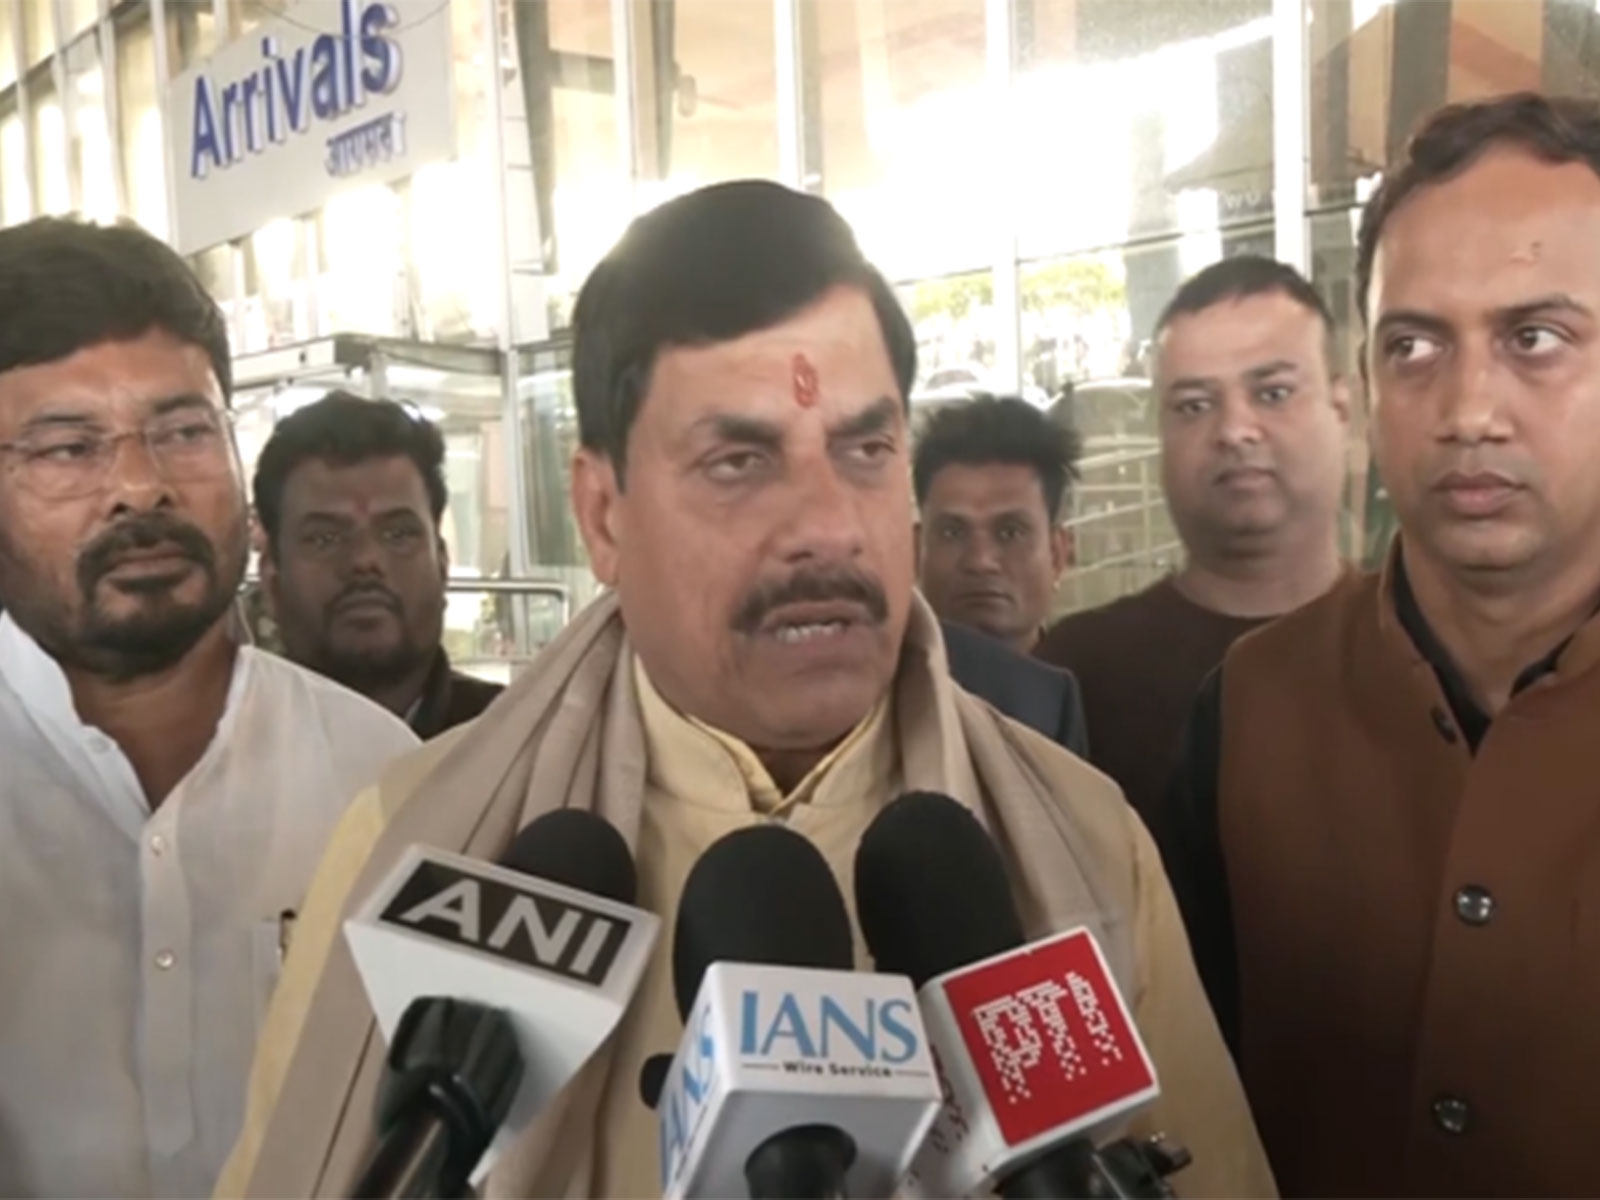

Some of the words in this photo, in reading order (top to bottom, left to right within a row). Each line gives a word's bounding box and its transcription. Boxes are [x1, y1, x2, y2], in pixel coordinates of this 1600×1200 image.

[190, 0, 400, 178] Arrivals
[397, 877, 614, 976] ANI
[739, 990, 918, 1064] IANS
[782, 1060, 824, 1075] Wire
[828, 1062, 893, 1078] Service
[971, 970, 1124, 1104] PTI
